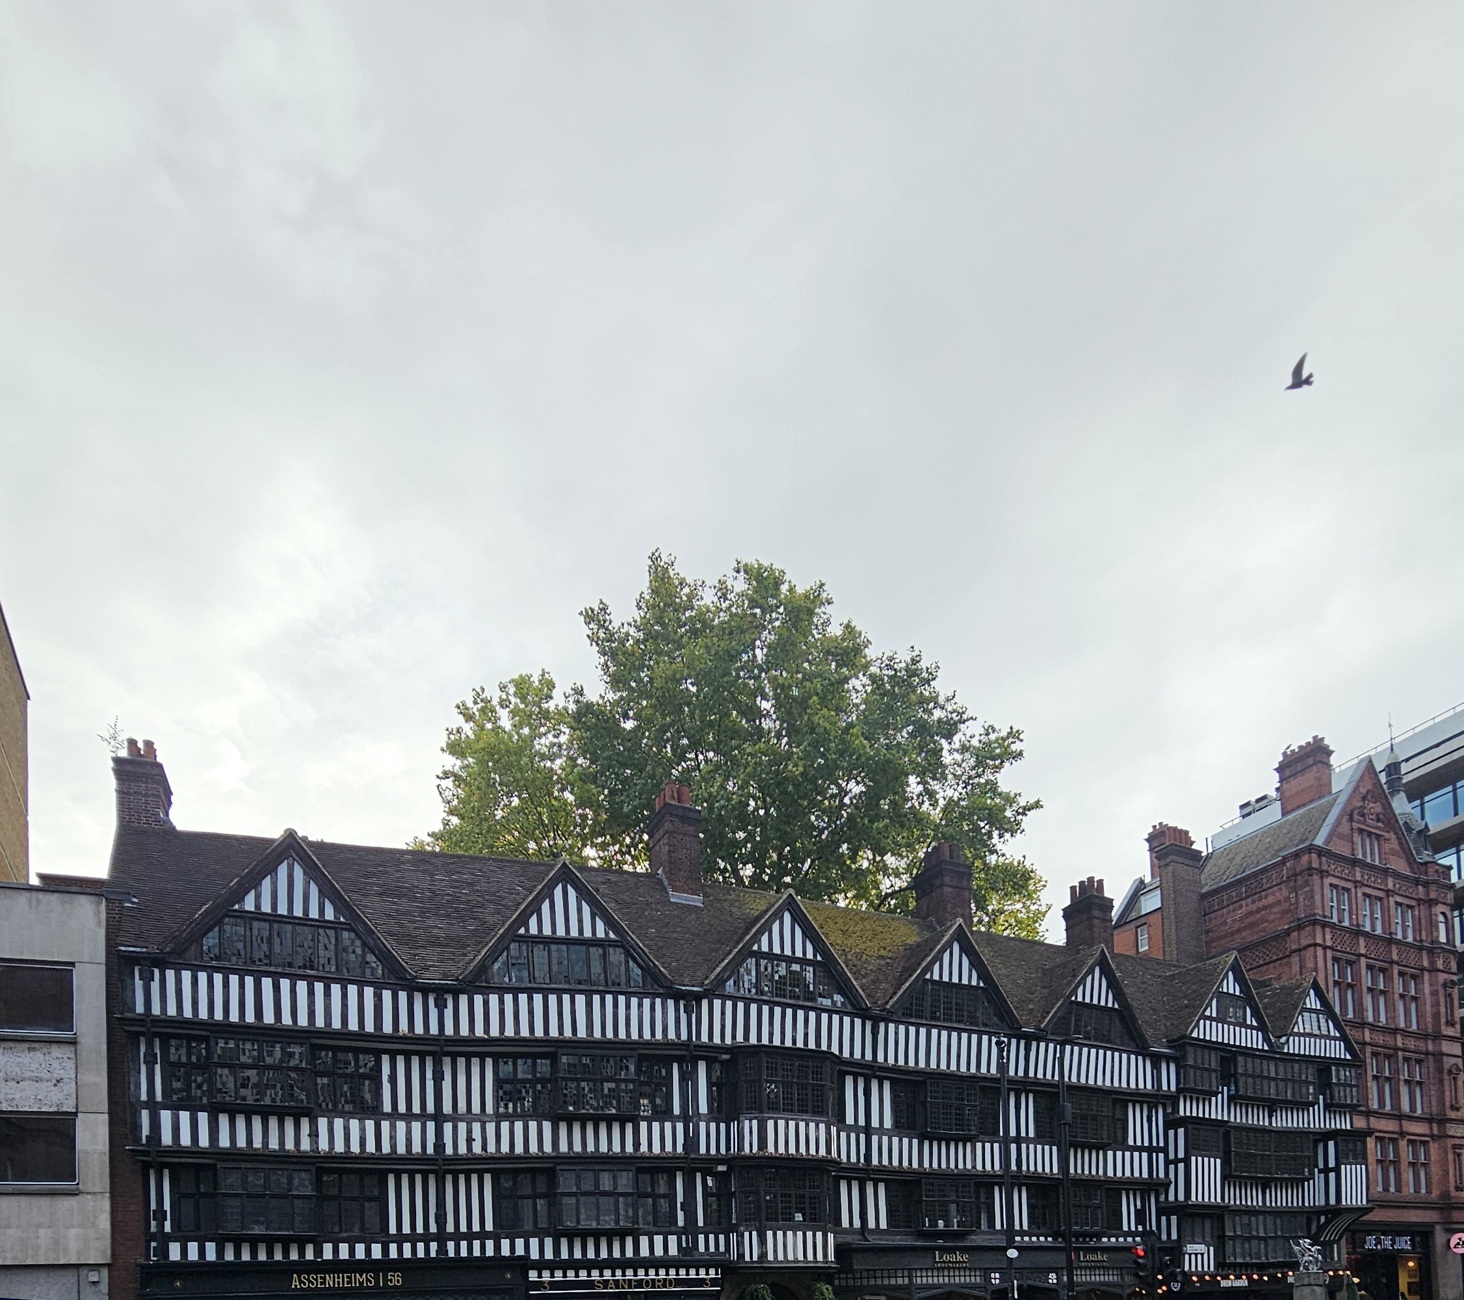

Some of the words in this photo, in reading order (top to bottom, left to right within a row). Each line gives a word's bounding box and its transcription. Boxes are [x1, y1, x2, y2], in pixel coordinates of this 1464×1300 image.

[1365, 1236, 1377, 1249] JOE
[1380, 1236, 1393, 1250] THE
[1394, 1236, 1412, 1250] JUICE
[935, 1251, 969, 1262] Loake
[1079, 1251, 1109, 1262] Loake
[291, 1272, 375, 1288] ASSENHEIMS
[387, 1272, 402, 1286] 56
[541, 1279, 550, 1291] 3
[594, 1278, 676, 1291] SANFORD
[702, 1277, 711, 1288] 3
